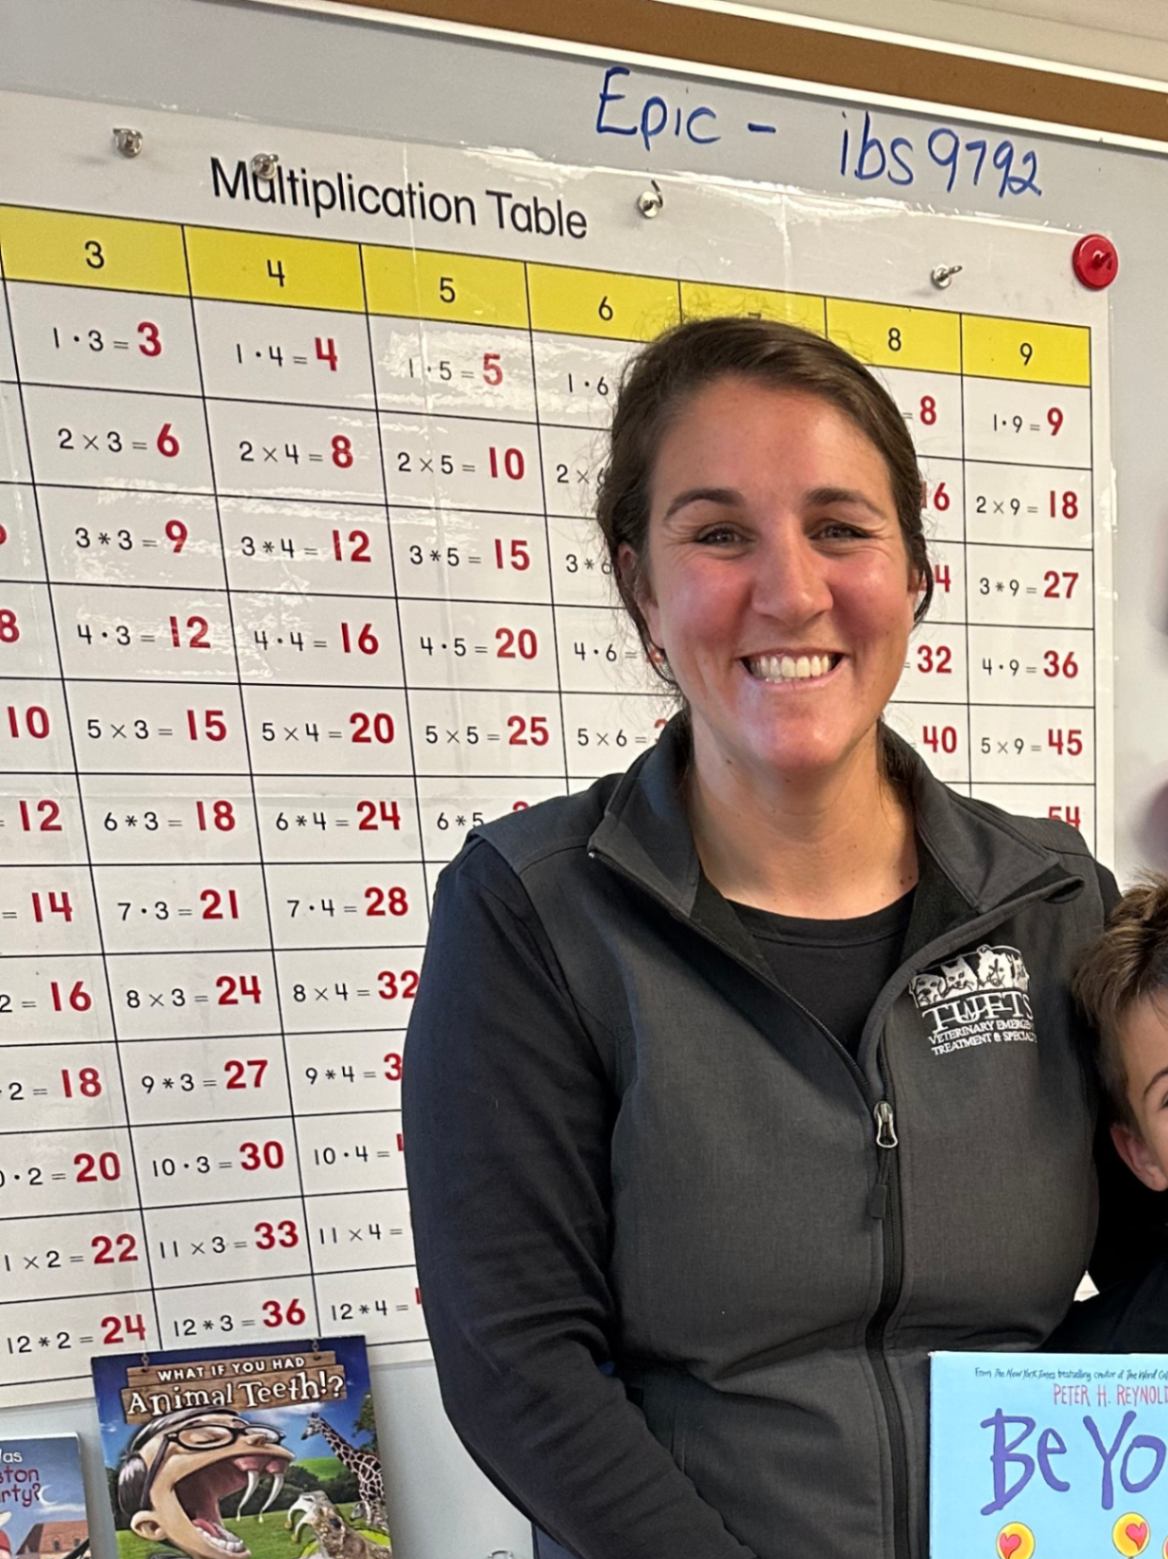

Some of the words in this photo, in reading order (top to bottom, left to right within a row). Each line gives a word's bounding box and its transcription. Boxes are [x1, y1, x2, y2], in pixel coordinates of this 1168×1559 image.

[596, 67, 721, 151] Epic
[210, 157, 477, 226] Multiplication
[486, 190, 589, 239] Table
[84, 242, 105, 269] 3
[267, 259, 286, 288] 4
[439, 277, 456, 303] 5
[598, 297, 614, 321] 6
[137, 321, 162, 358] 3
[314, 337, 338, 372] 4
[887, 327, 902, 352] 8
[1019, 342, 1034, 367] 9
[483, 352, 503, 385] 5
[919, 395, 938, 426] 8
[1047, 407, 1064, 434] 9
[156, 423, 180, 458] 6
[331, 434, 354, 470] 8
[489, 447, 525, 481] 10
[1050, 491, 1078, 520] 18
[164, 519, 189, 554] 9
[332, 528, 371, 564] 12
[495, 538, 530, 572] 15
[1043, 570, 1078, 599] 27
[169, 615, 209, 649] 12
[340, 623, 380, 656] 16
[495, 627, 538, 661] 20
[918, 644, 952, 674] 32
[1043, 650, 1079, 679] 36
[7, 705, 50, 740] 10
[187, 708, 228, 742] 15
[350, 711, 395, 745] 20
[507, 715, 550, 747] 25
[922, 725, 958, 754] 40
[1047, 728, 1083, 756] 45
[19, 799, 62, 833] 12
[196, 799, 236, 833] 18
[356, 799, 401, 832] 24
[31, 892, 73, 923] 14
[199, 888, 239, 921] 21
[364, 885, 410, 917] 28
[50, 980, 92, 1012] 16
[215, 975, 261, 1006] 24
[378, 969, 420, 1001] 32
[922, 990, 1034, 1034] TUFTS
[929, 1020, 995, 1046] VETERINARY
[931, 1032, 992, 1056] TREATMENT
[62, 1067, 102, 1098] 18
[224, 1058, 268, 1090] 27
[74, 1151, 121, 1183] 20
[240, 1140, 285, 1171] 30
[91, 1233, 137, 1265] 22
[255, 1219, 300, 1250] 33
[263, 1299, 306, 1328] 36
[101, 1315, 146, 1345] 24
[157, 1366, 204, 1382] WHAT
[211, 1364, 226, 1377] IF
[232, 1360, 267, 1375] YOU
[272, 1356, 306, 1369] HAD
[126, 1383, 234, 1417] Animal
[239, 1369, 345, 1409] Teeth!?
[1053, 1383, 1091, 1407] PETER
[1097, 1384, 1111, 1407] H.
[980, 1407, 1072, 1515] Be
